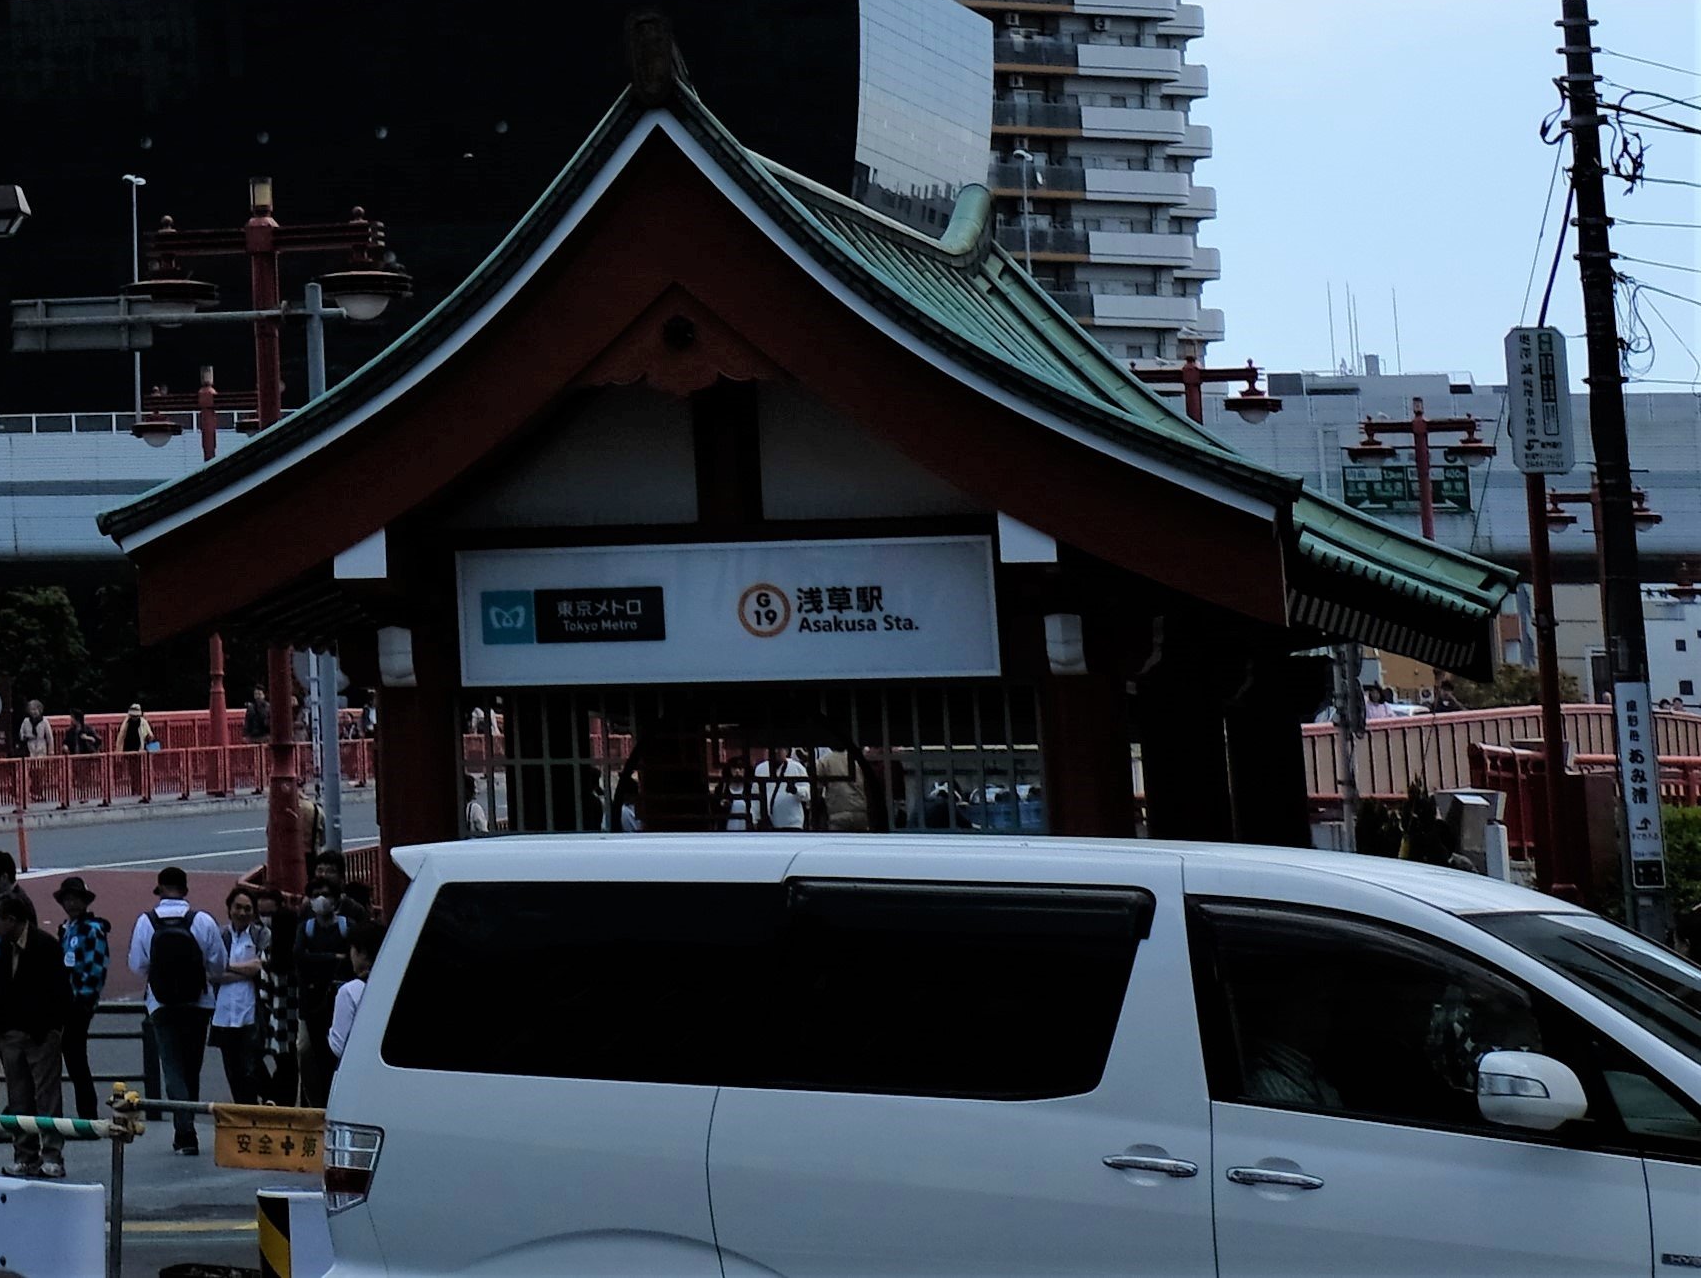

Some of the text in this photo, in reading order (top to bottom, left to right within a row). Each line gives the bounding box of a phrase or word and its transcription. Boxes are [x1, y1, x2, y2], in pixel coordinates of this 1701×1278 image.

[556, 598, 643, 618] 東京メトロ
[756, 593, 771, 608] G
[797, 586, 884, 614] 浅草駅
[563, 618, 638, 634] Tokyo Metro
[754, 609, 778, 626] 19
[799, 614, 920, 633] Asakusa Sta.
